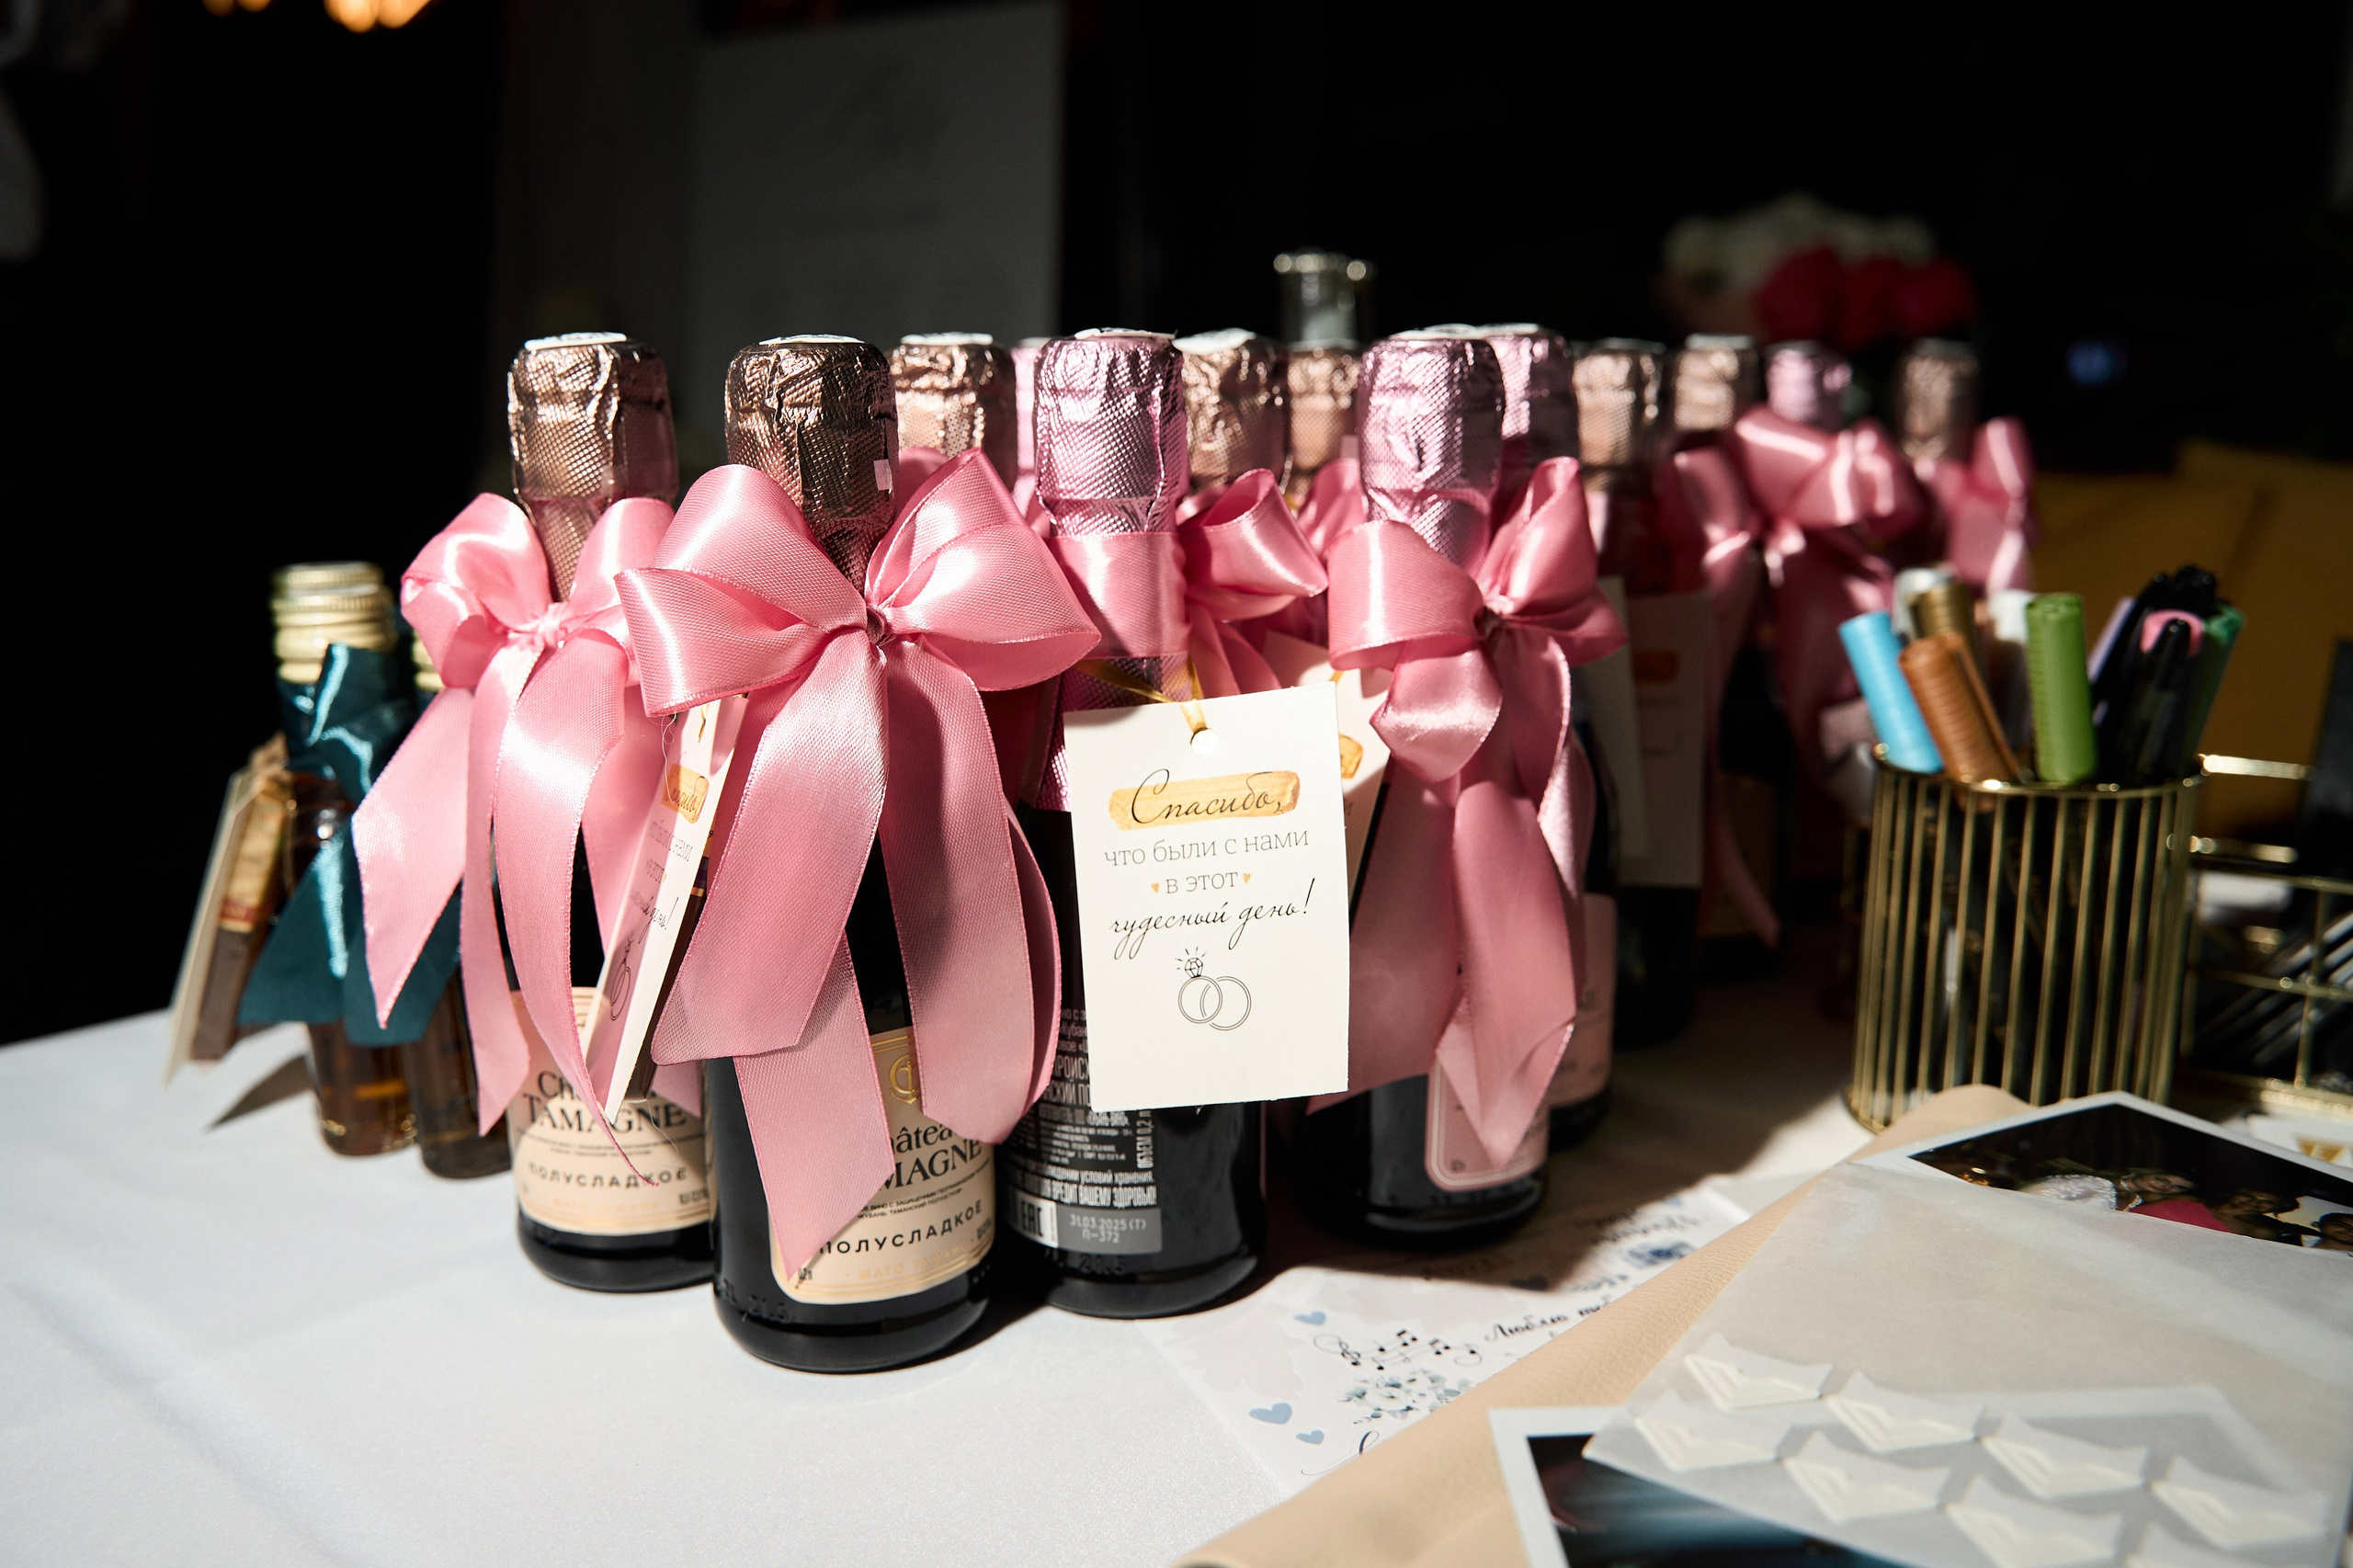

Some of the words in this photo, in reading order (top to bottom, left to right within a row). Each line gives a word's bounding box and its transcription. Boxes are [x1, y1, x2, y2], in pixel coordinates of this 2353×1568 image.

[1131, 768, 1281, 824] Спасибо,
[1105, 848, 1146, 867] что
[1153, 838, 1217, 863] были
[1224, 837, 1237, 855] с
[1245, 830, 1309, 853] нами
[1165, 878, 1178, 894] в
[1186, 871, 1238, 892] этот
[1109, 902, 1232, 960] чудесный
[1228, 877, 1316, 950] день!
[523, 1091, 688, 1134] TAMGNE
[529, 1161, 688, 1189] ПОЛУСЛАДКОЕ
[819, 1199, 983, 1255] ПОЛУСЛАДКОЕ
